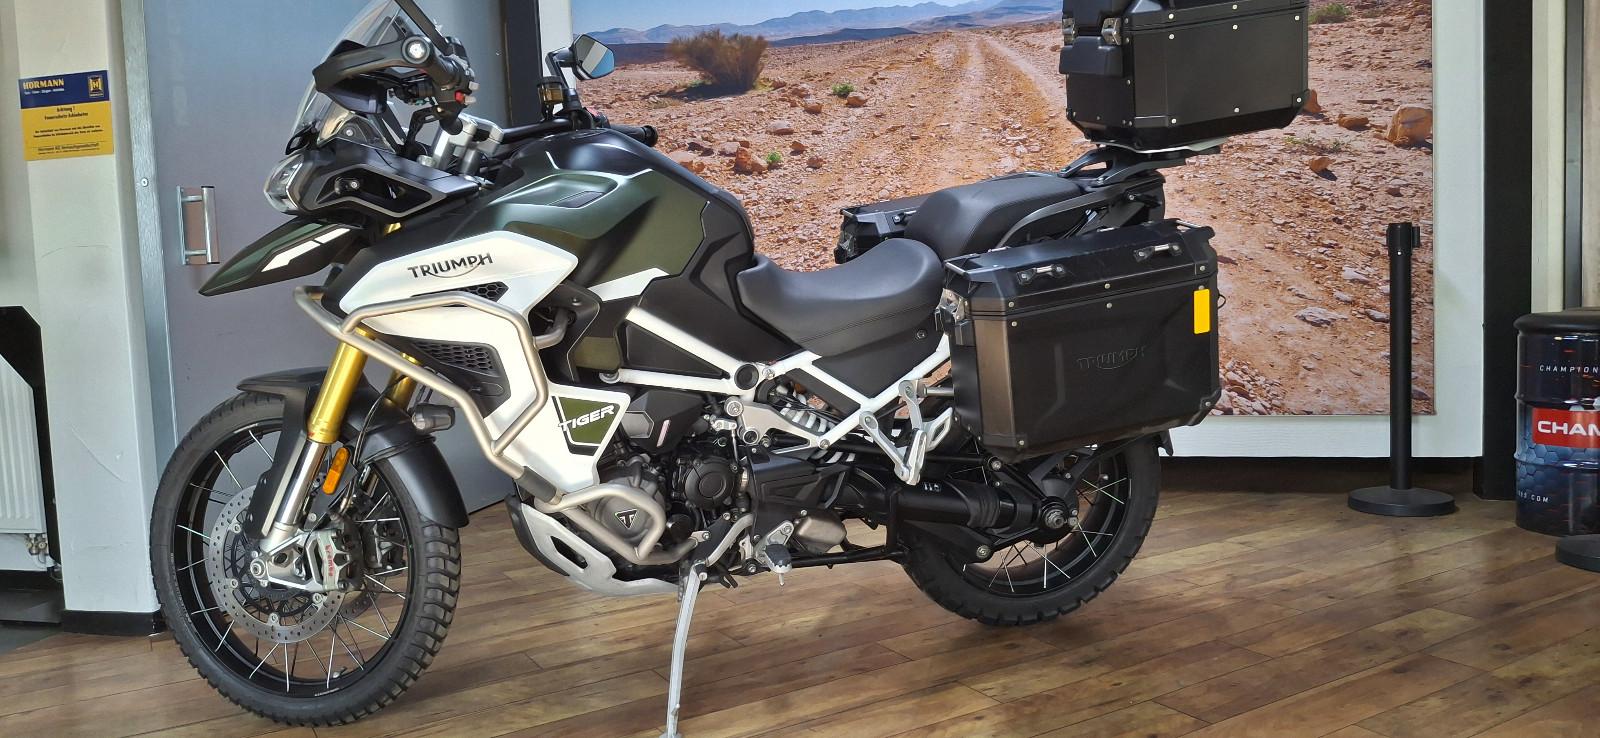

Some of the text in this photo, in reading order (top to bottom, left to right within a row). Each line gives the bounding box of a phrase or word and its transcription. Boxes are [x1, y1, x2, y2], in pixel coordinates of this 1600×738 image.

[407, 253, 494, 278] TRIUMPH
[1539, 364, 1599, 374] CHAMPION
[558, 404, 615, 432] TIGER
